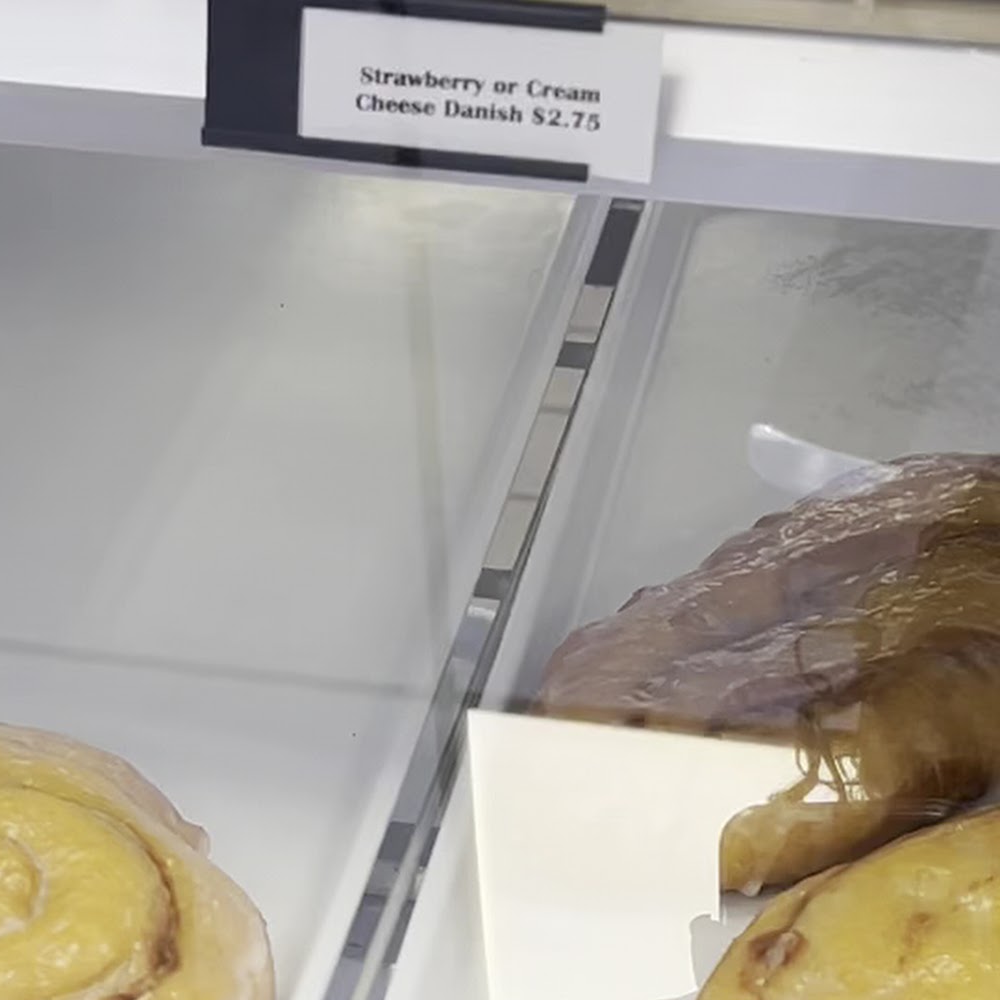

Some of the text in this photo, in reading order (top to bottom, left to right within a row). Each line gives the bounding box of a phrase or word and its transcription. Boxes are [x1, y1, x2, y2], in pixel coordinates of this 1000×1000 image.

[360, 66, 602, 103] Strawberry or Cream
[355, 93, 601, 131] Cheese Danish $2.75
